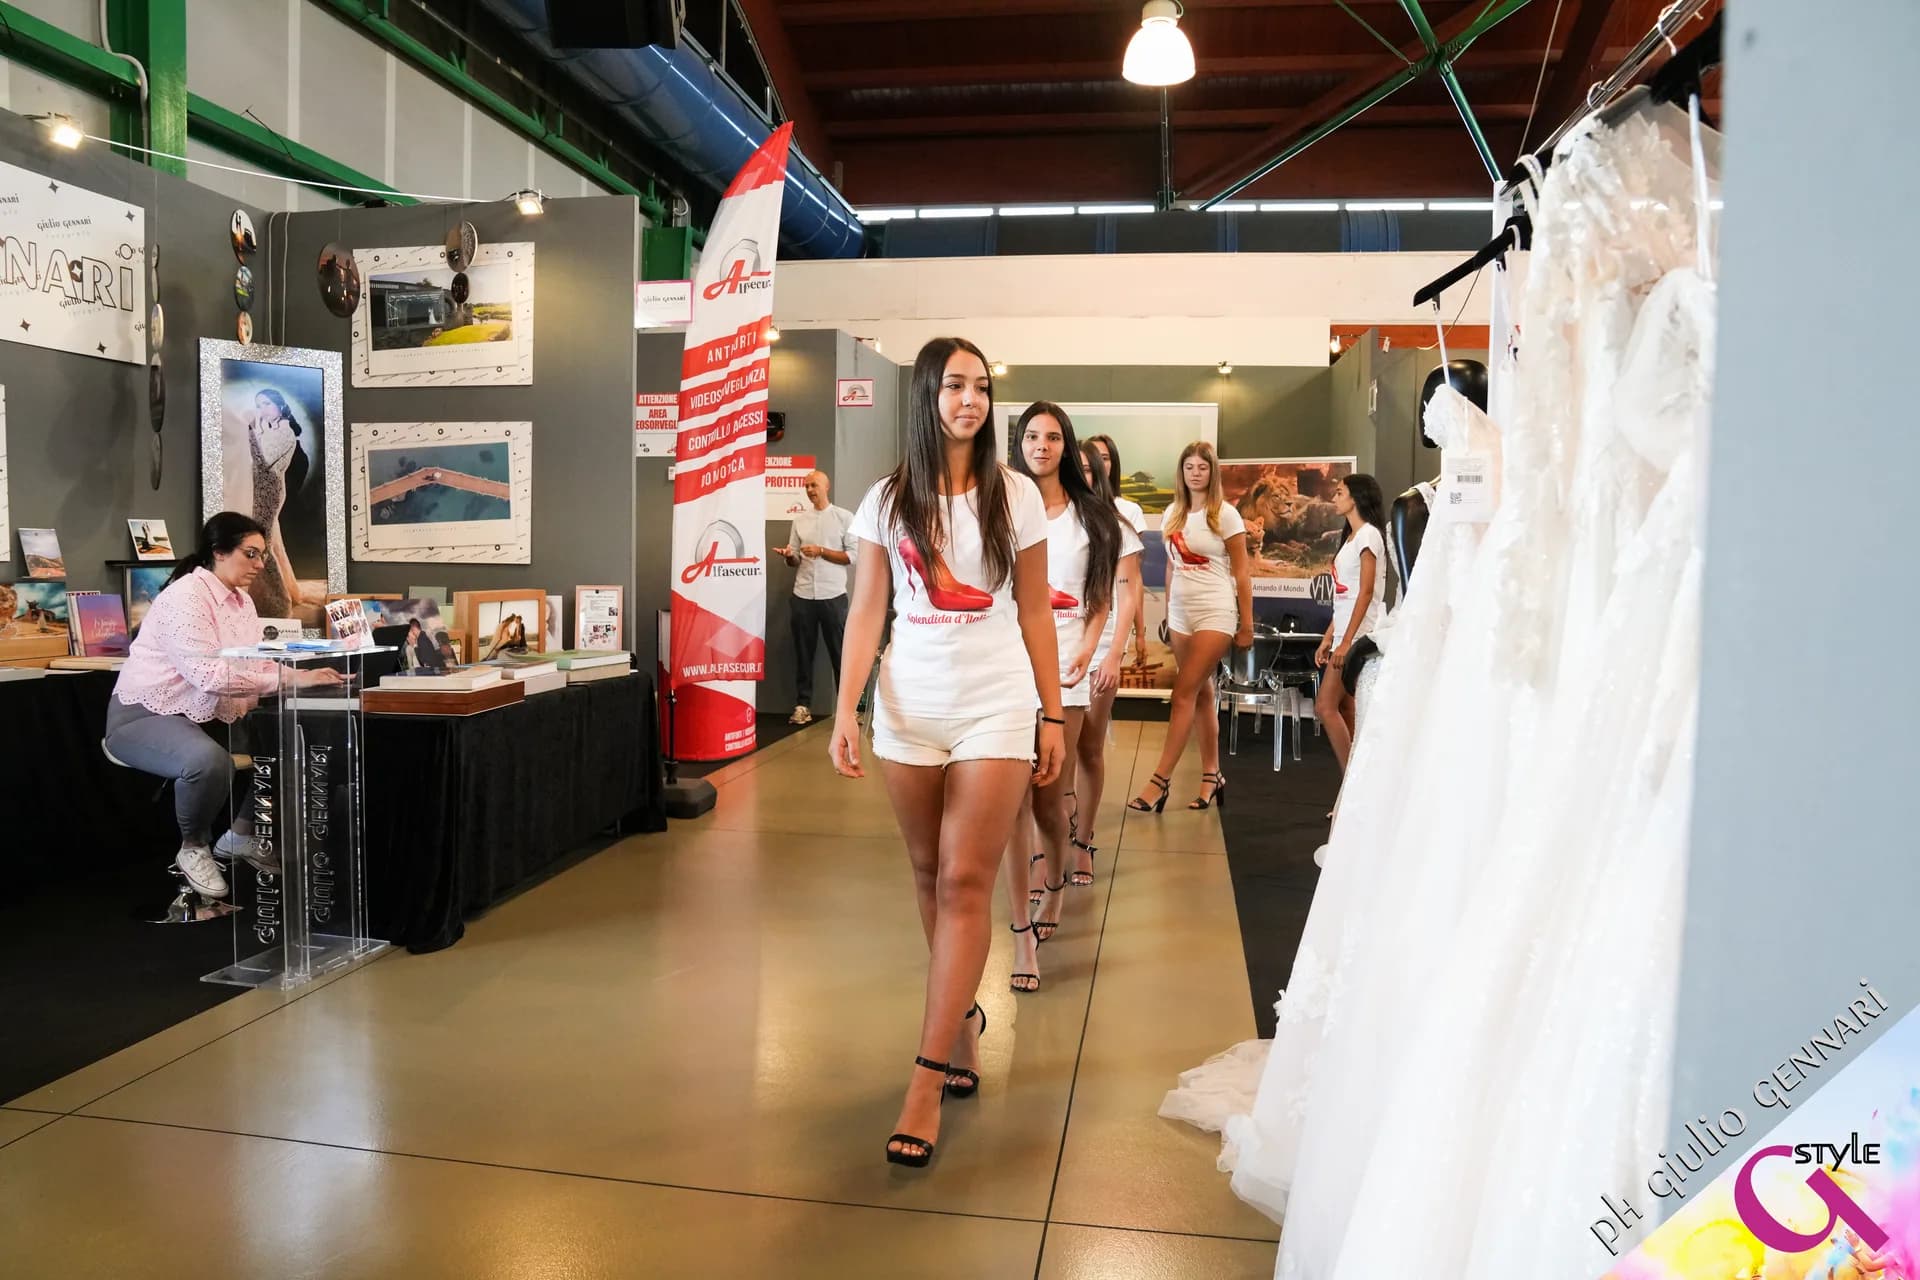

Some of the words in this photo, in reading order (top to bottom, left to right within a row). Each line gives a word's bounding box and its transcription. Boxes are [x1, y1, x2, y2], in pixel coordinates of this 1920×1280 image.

[649, 409, 667, 418] AREA
[1253, 584, 1277, 592] Amando
[1283, 585, 1305, 593] Mondo
[954, 611, 990, 625] d'Itali
